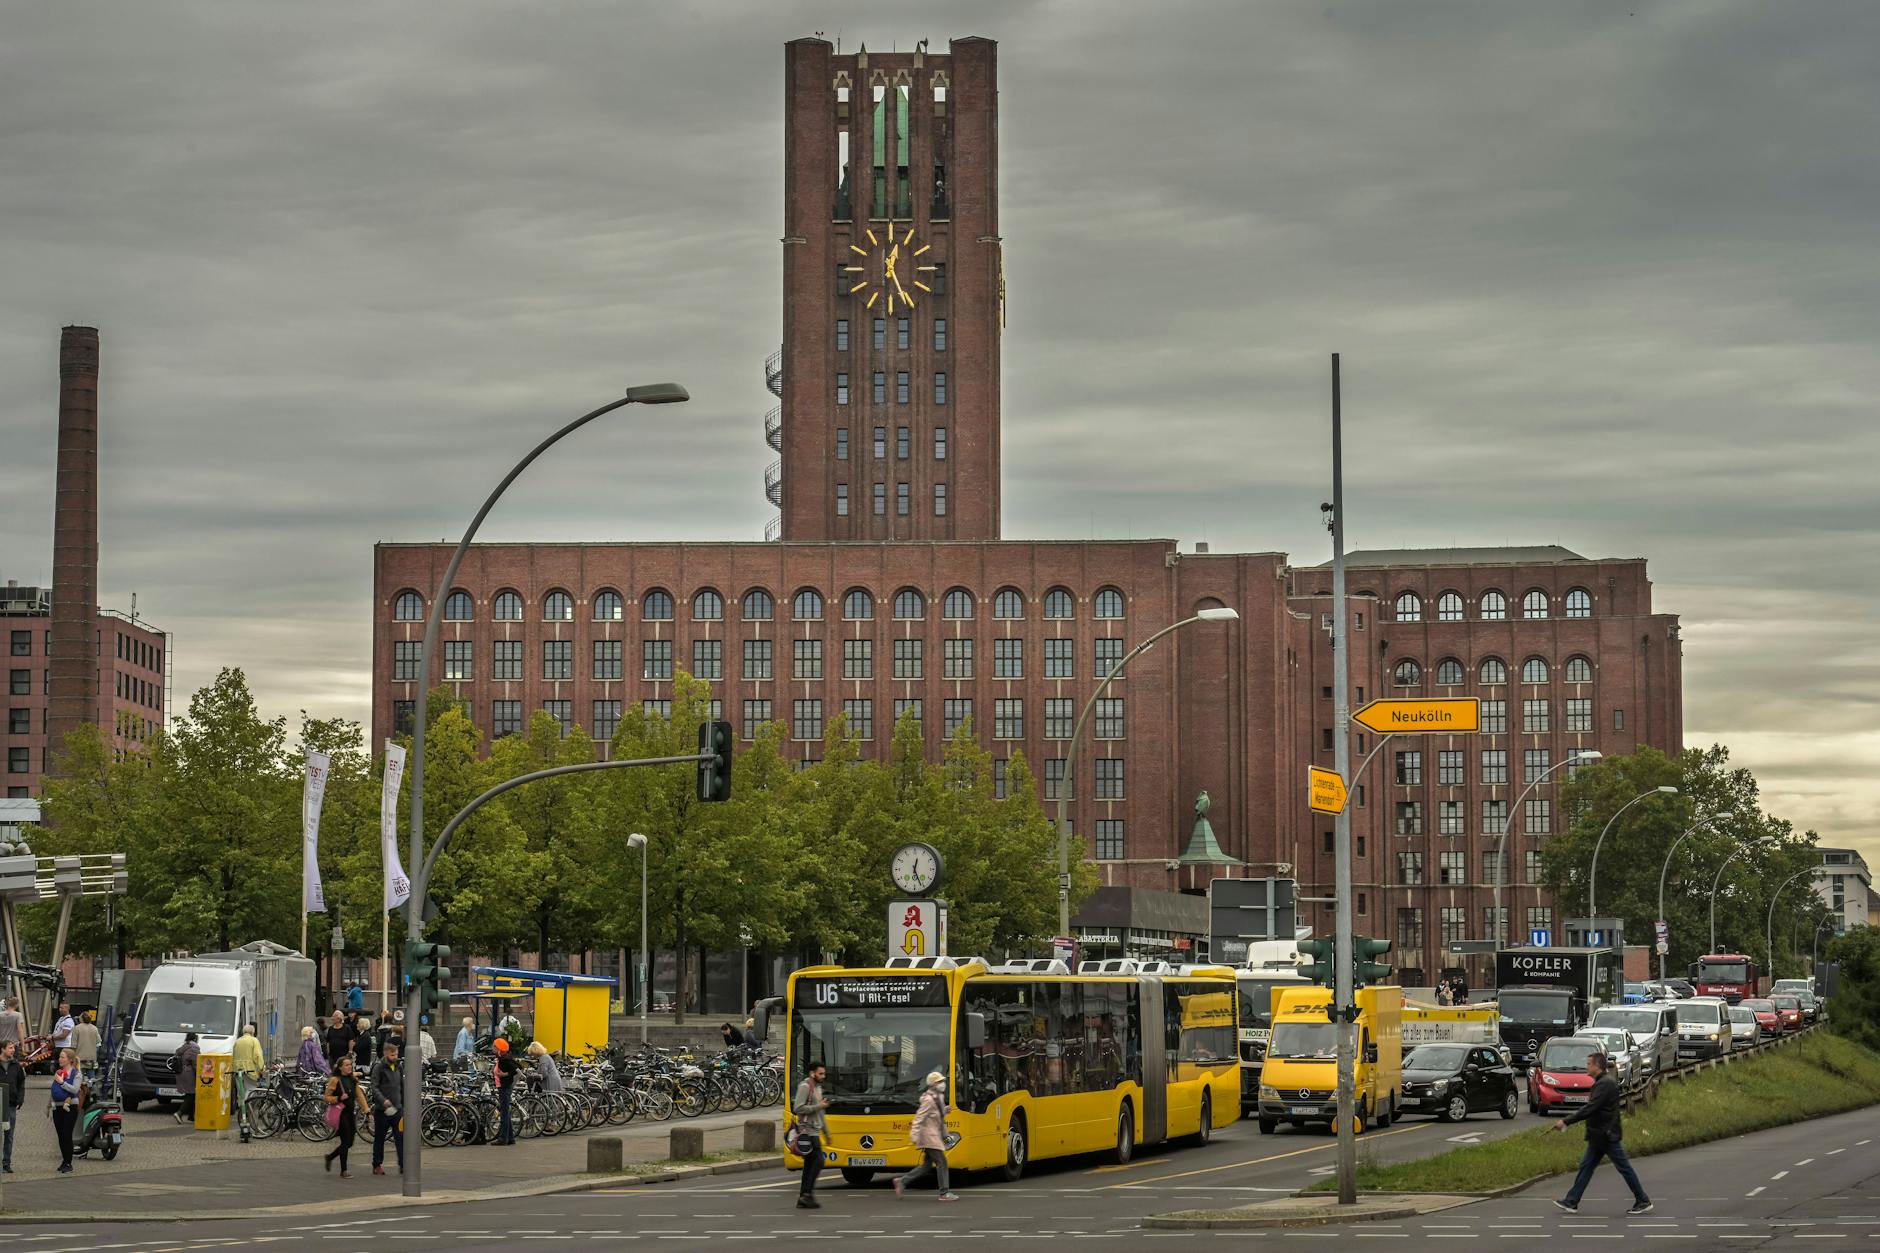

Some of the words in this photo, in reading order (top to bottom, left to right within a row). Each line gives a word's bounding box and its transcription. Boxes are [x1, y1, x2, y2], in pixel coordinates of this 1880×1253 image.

[1391, 709, 1453, 723] Neukölln
[1533, 932, 1547, 947] U
[1512, 957, 1572, 970] KOFLER
[816, 983, 839, 1004] U6
[843, 985, 888, 993] Replacement
[859, 993, 866, 1003] U
[868, 992, 911, 1003] Alt-Tegel
[1291, 1004, 1328, 1014] DH
